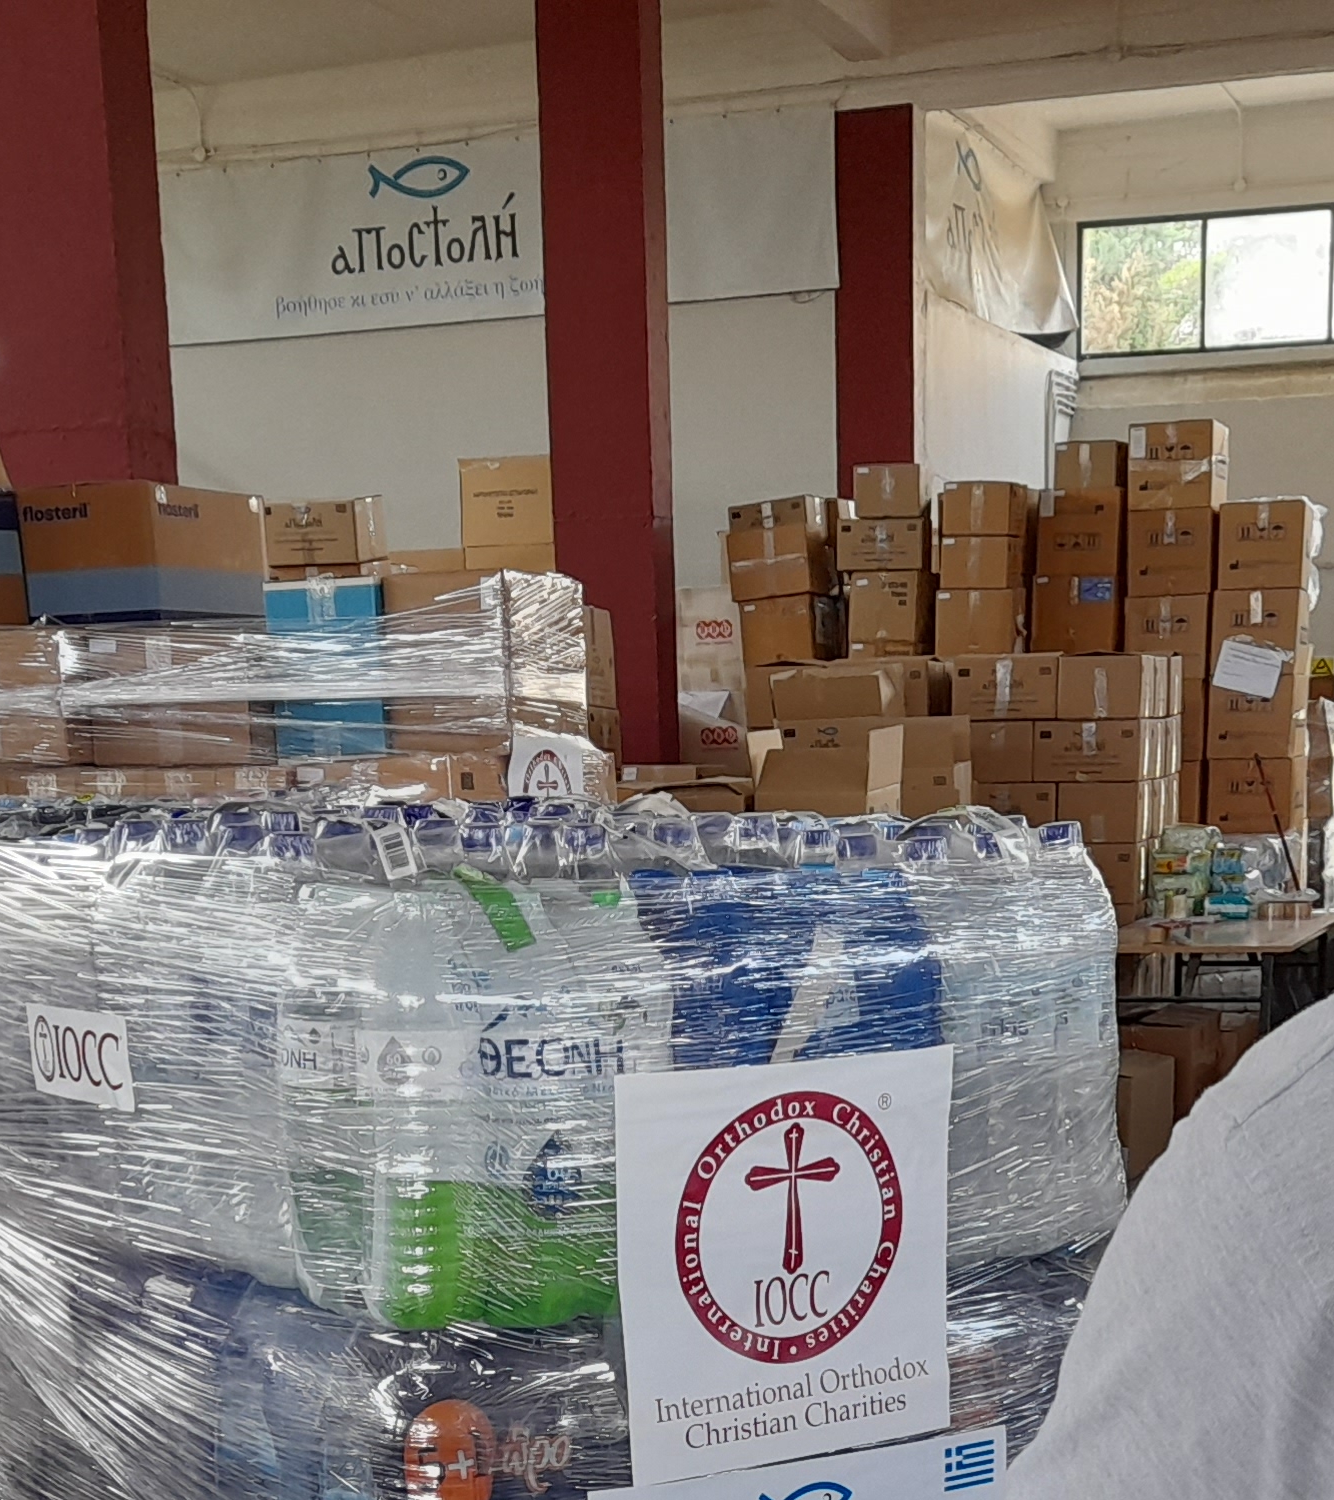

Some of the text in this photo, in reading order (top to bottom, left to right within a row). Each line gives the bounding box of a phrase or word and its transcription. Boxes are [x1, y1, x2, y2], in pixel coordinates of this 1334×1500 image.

[371, 289, 399, 306] εσύ
[424, 279, 490, 301] αλλάξει
[495, 280, 505, 299] η
[23, 504, 88, 522] flosteril
[52, 1023, 122, 1092] IOCC
[682, 1097, 898, 1360] International Orthodox Christian Charities
[753, 1270, 830, 1329] IOCC
[655, 1356, 930, 1424] International Orthodox
[685, 1390, 907, 1450] Christian Charities
